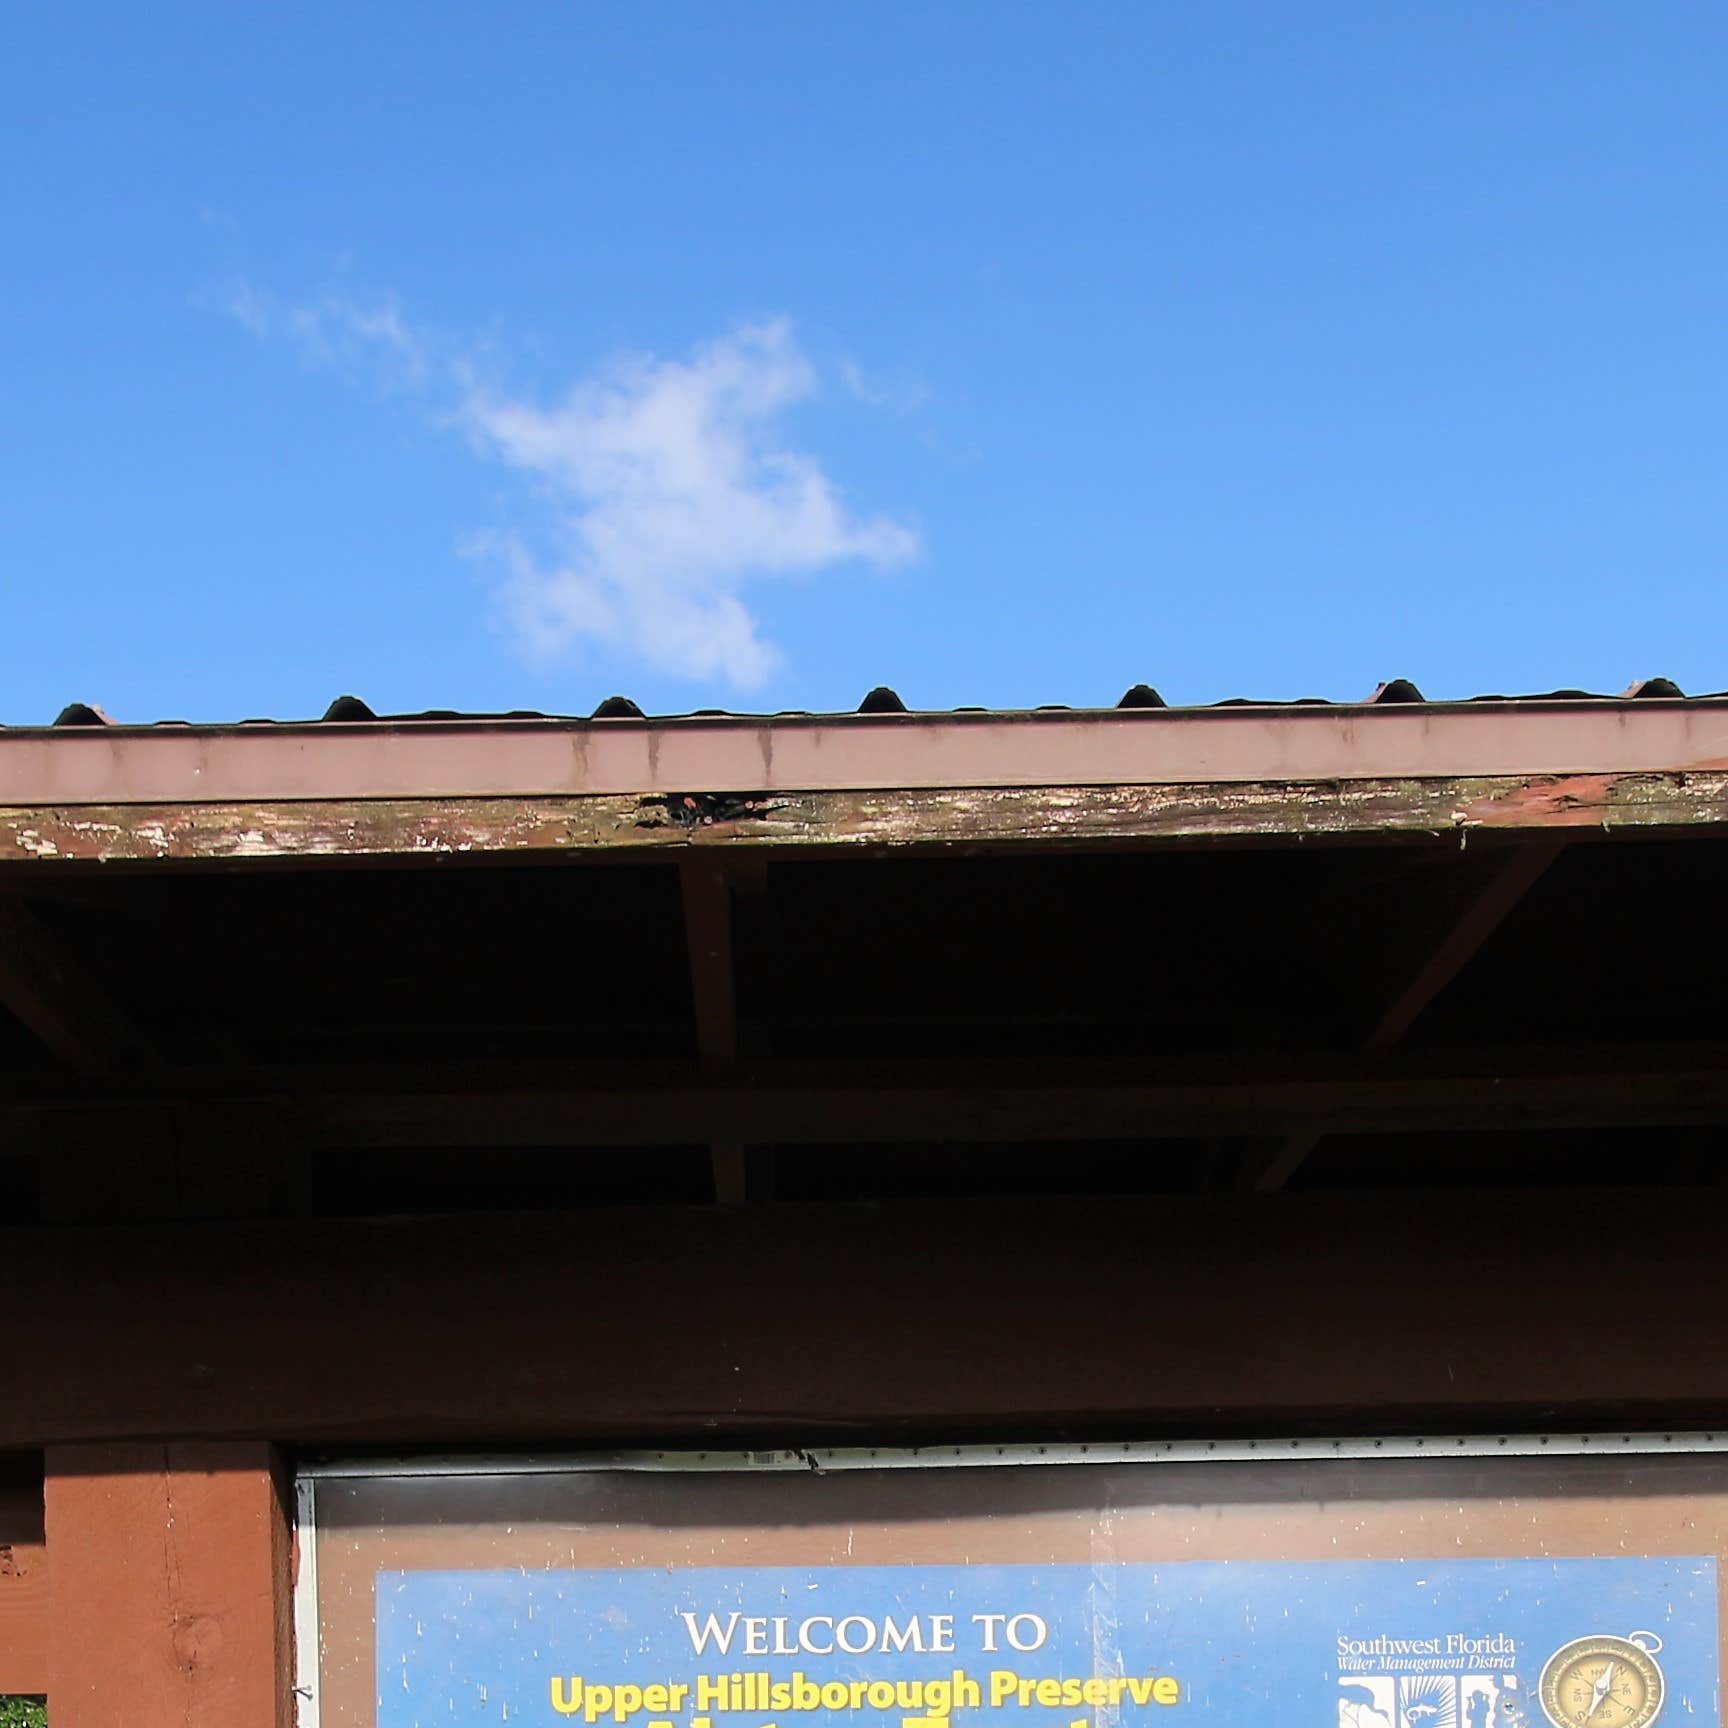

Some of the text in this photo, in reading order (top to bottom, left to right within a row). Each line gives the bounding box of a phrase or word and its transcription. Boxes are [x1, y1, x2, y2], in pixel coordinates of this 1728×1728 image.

[682, 1608, 1048, 1656] WELCOME TO
[1336, 1632, 1515, 1656] Southwest Florida
[1337, 1654, 1516, 1674] Water Management District
[549, 1668, 1179, 1724] Upper Hillsborough Preserve
